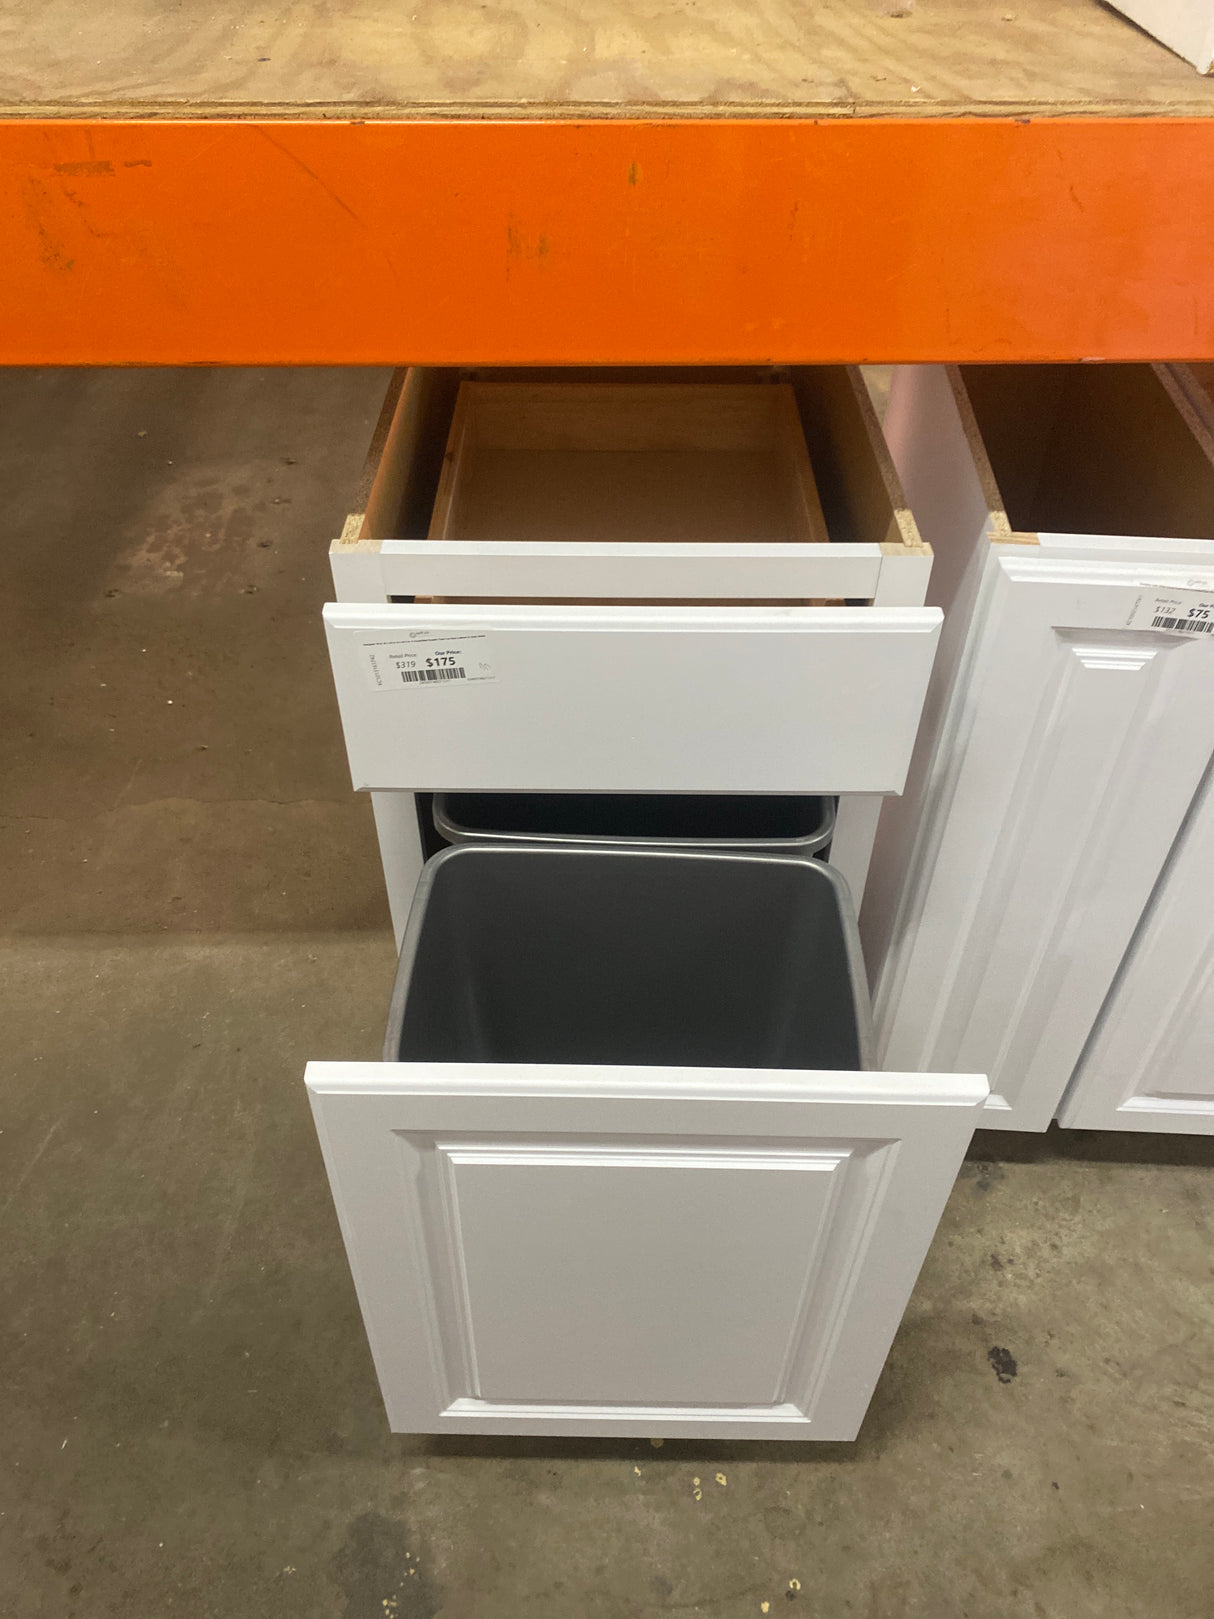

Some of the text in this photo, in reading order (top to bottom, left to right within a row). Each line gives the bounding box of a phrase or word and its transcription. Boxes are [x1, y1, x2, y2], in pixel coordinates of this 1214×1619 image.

[1187, 608, 1210, 618] $75
[396, 661, 416, 669] $319
[425, 657, 456, 668] $175
